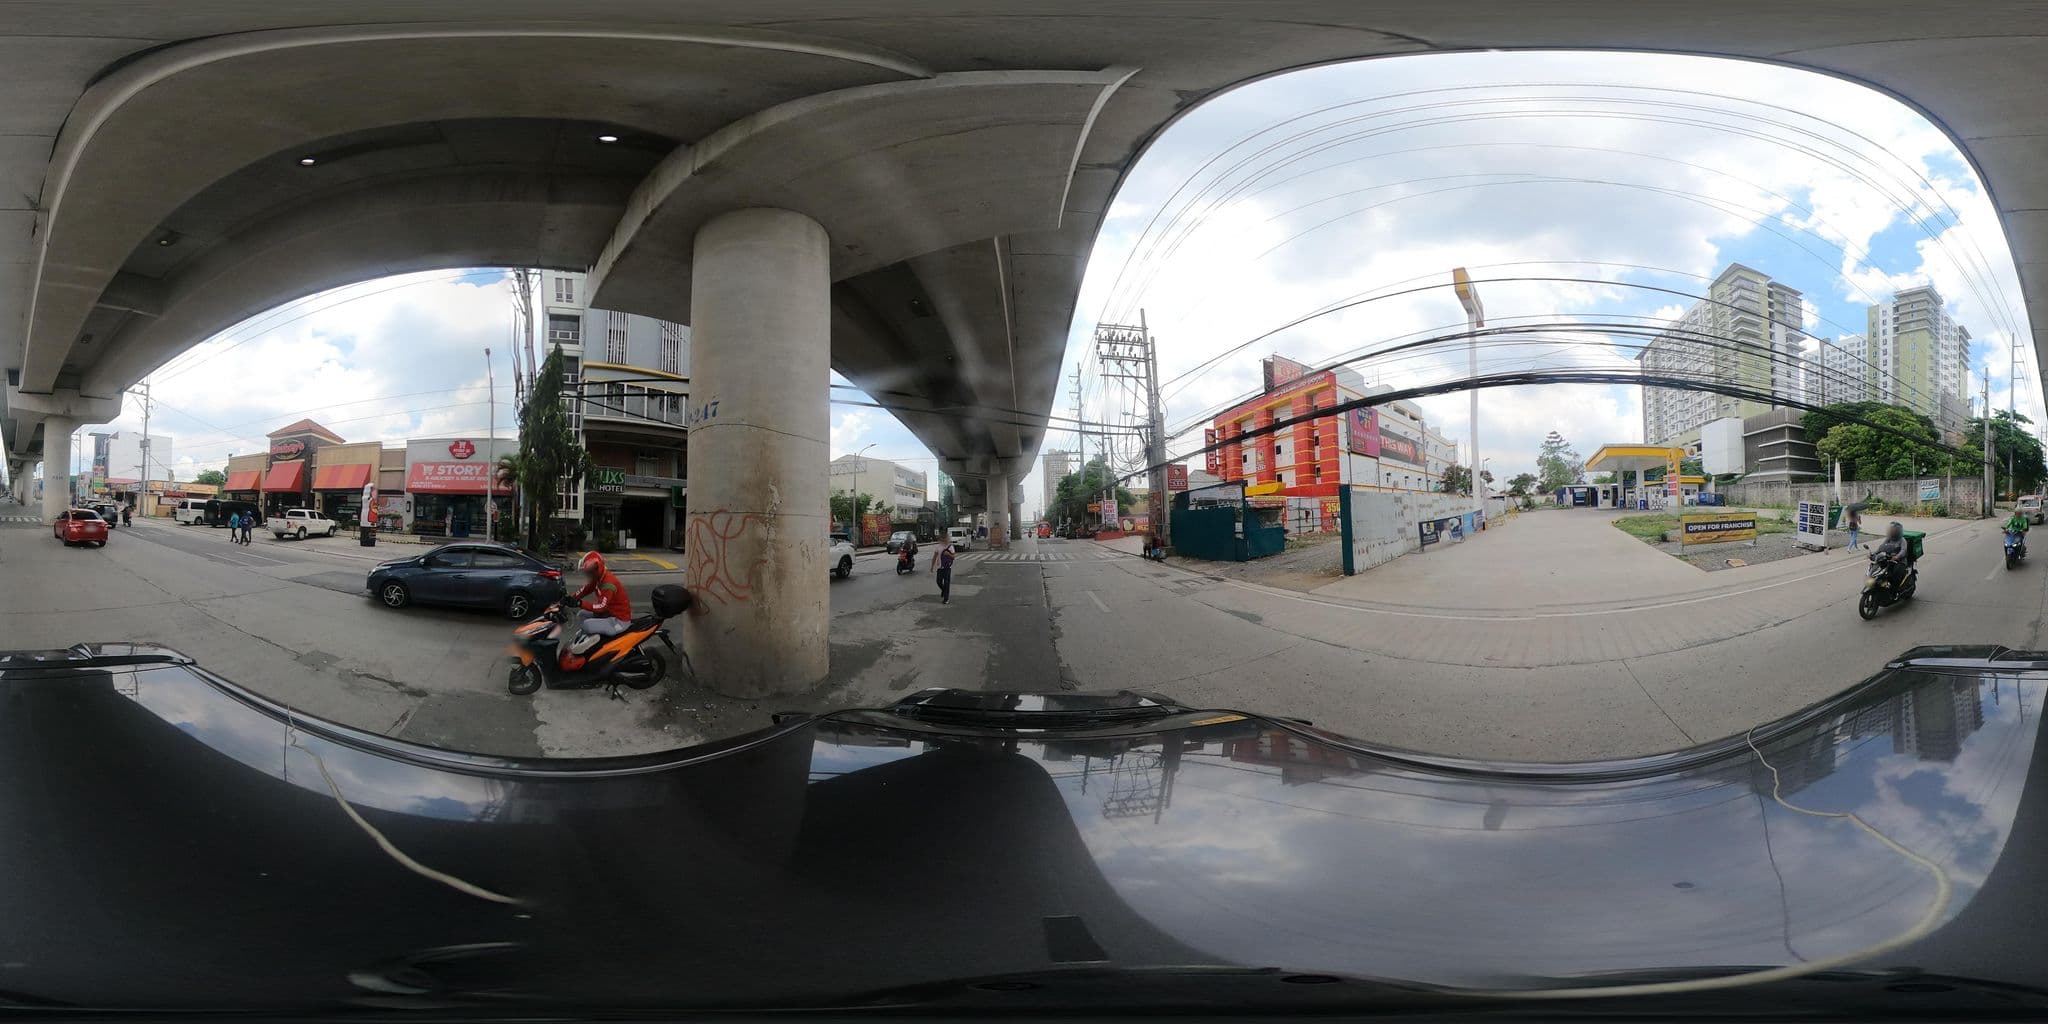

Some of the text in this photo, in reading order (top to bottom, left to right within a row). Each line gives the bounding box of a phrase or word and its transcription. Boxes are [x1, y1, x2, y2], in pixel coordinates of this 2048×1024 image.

[437, 464, 483, 476] STORY
[599, 484, 624, 493] HOTEL
[1688, 524, 1707, 532] OPEN
[1721, 521, 1753, 530] FRANCHISE
